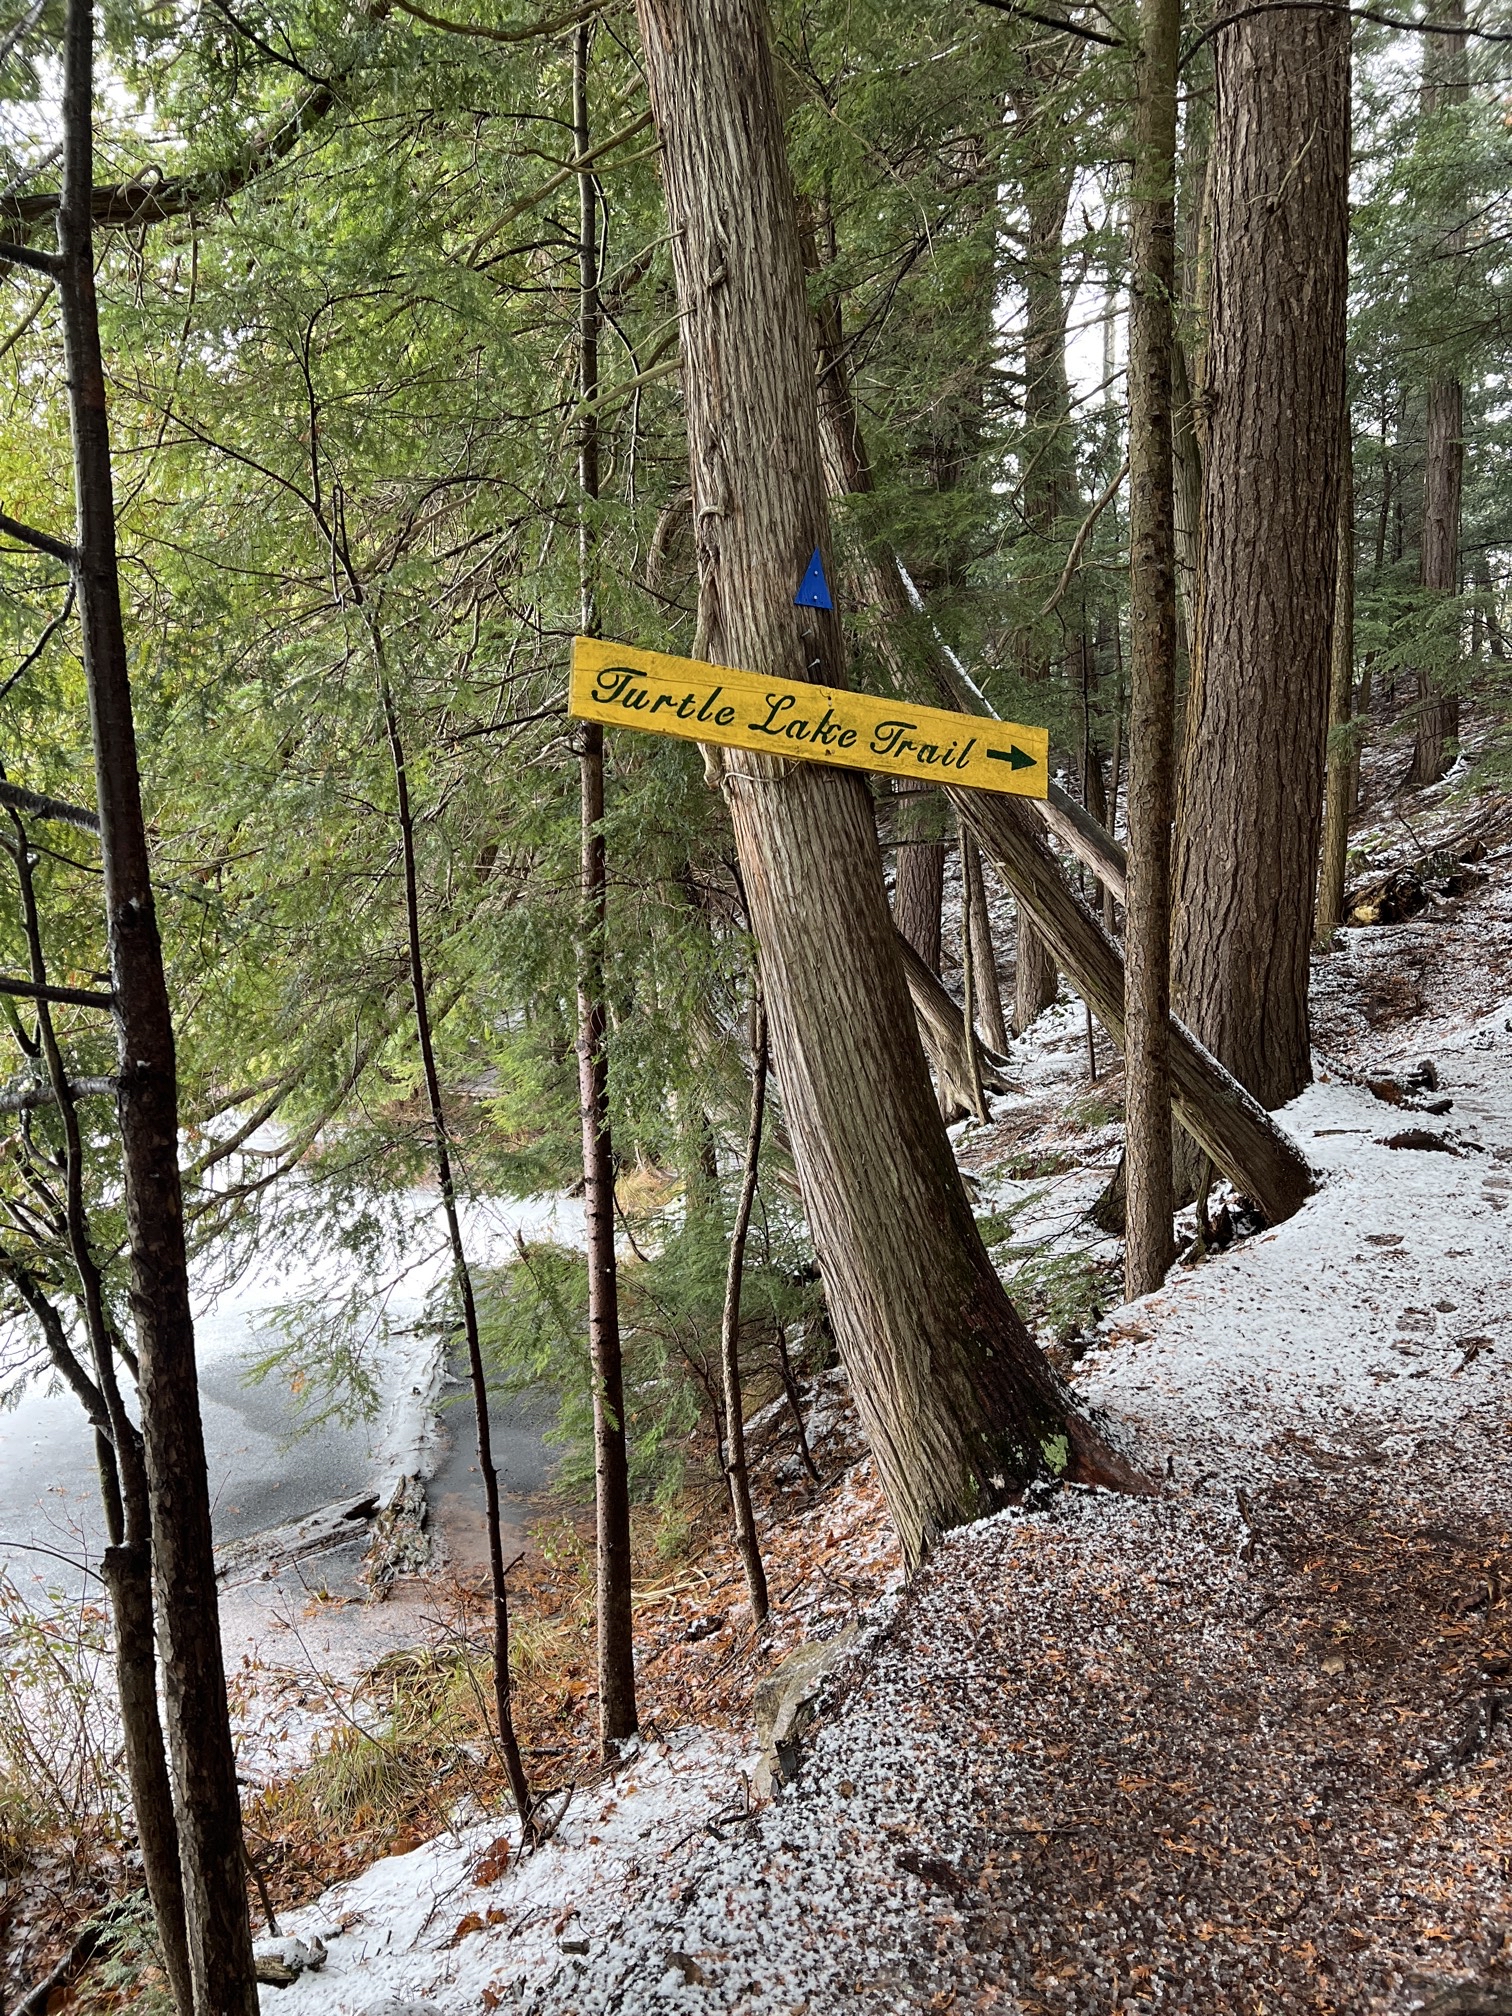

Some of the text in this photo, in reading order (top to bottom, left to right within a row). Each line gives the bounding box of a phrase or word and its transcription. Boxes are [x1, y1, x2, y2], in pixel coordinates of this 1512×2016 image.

[591, 667, 976, 770] Turtle Lake Trail
